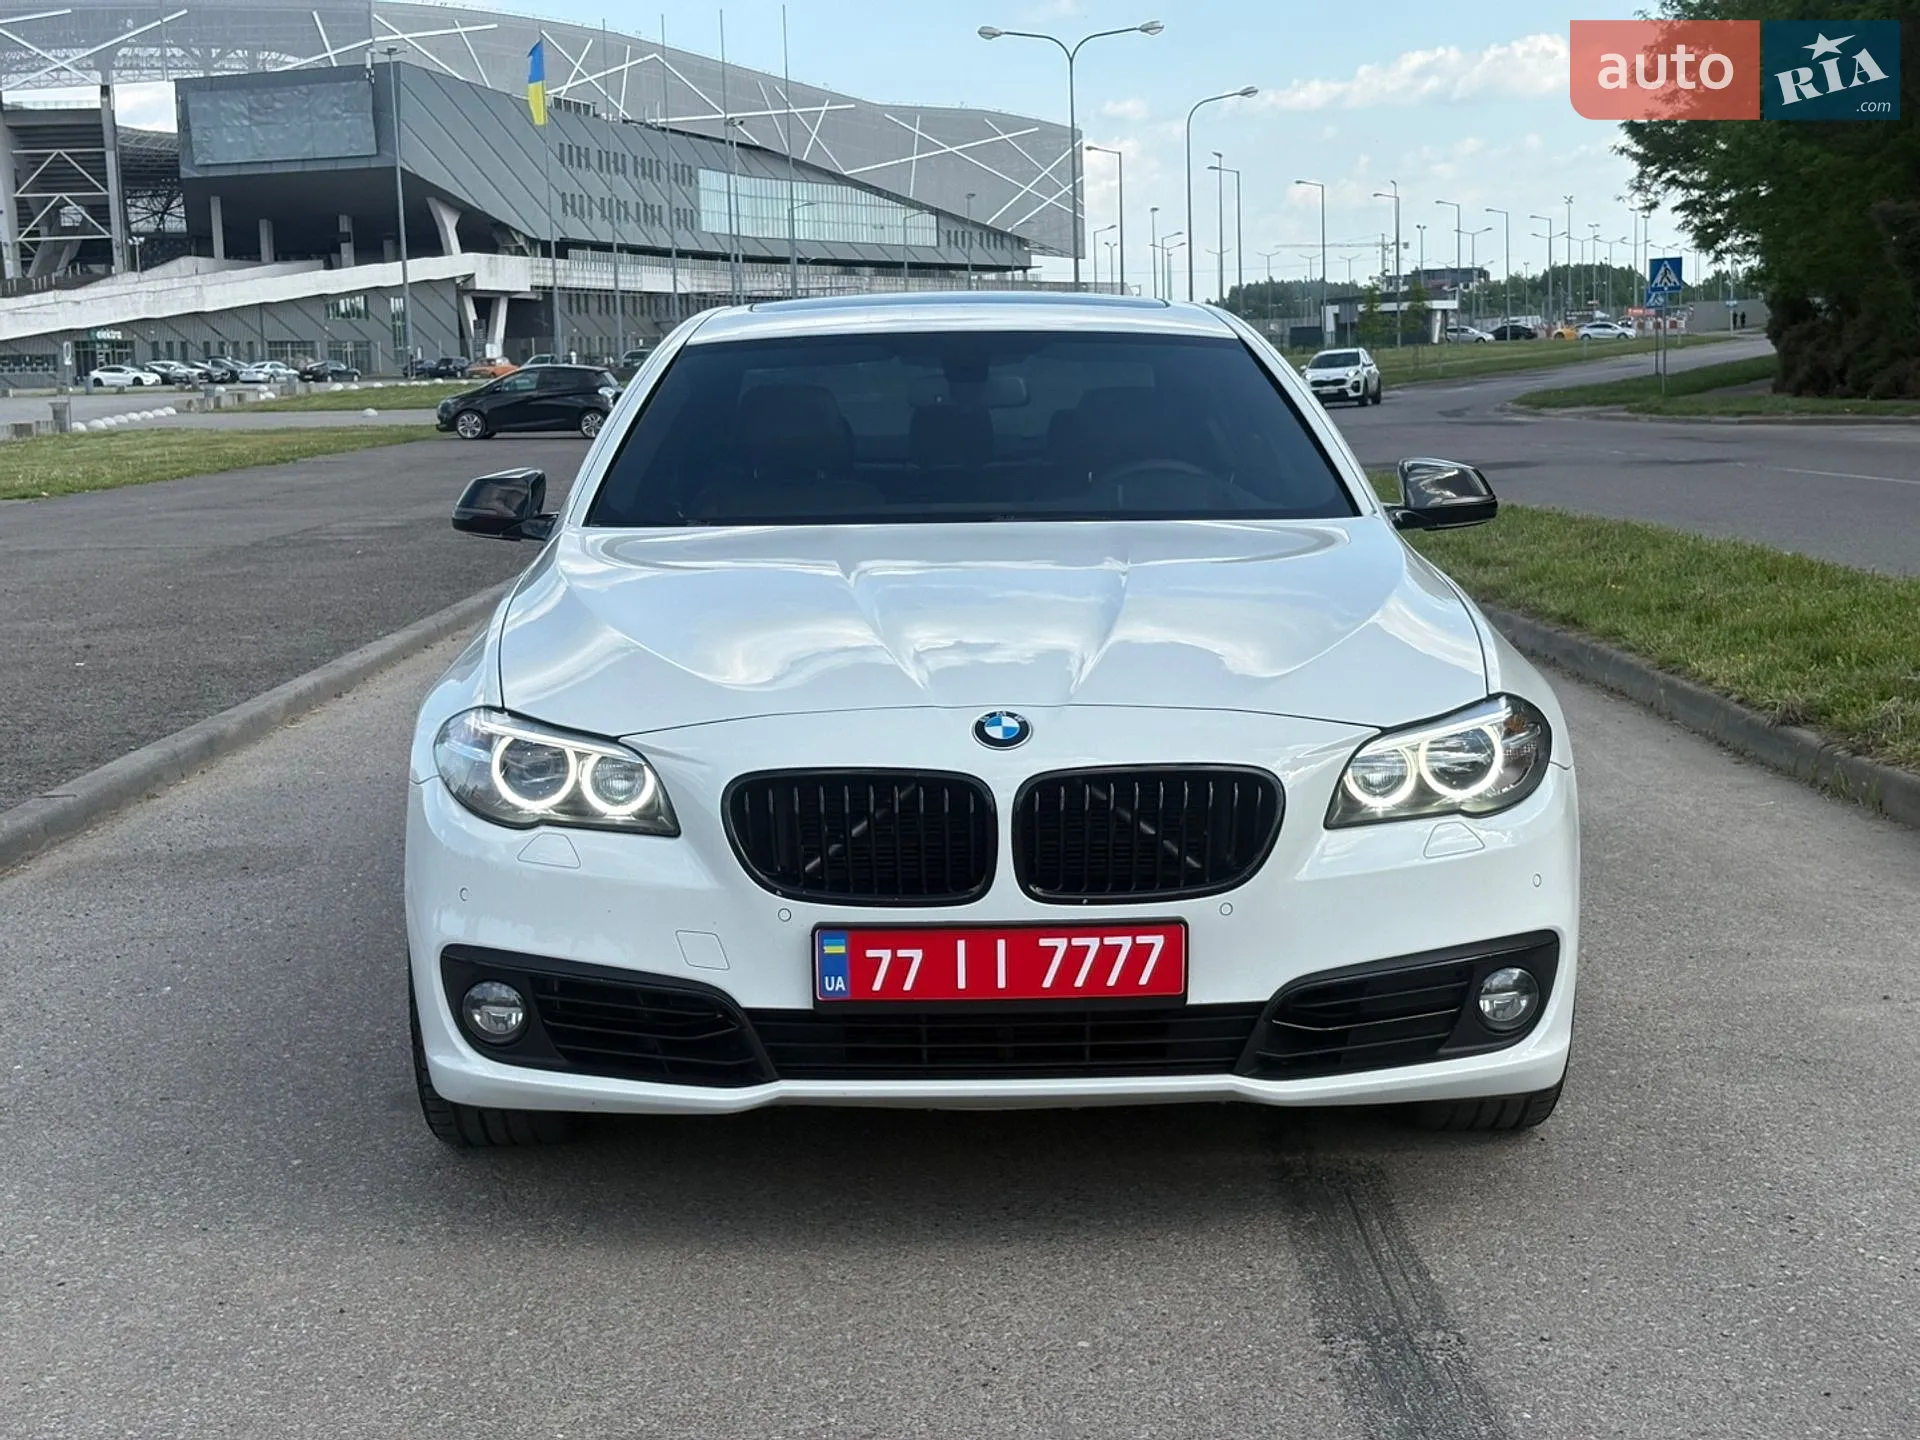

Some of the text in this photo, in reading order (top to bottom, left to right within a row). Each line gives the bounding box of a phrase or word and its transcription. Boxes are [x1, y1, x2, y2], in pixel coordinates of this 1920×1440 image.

[865, 949, 923, 991] 77
[1038, 934, 1165, 988] 7777
[825, 976, 846, 992] UA
